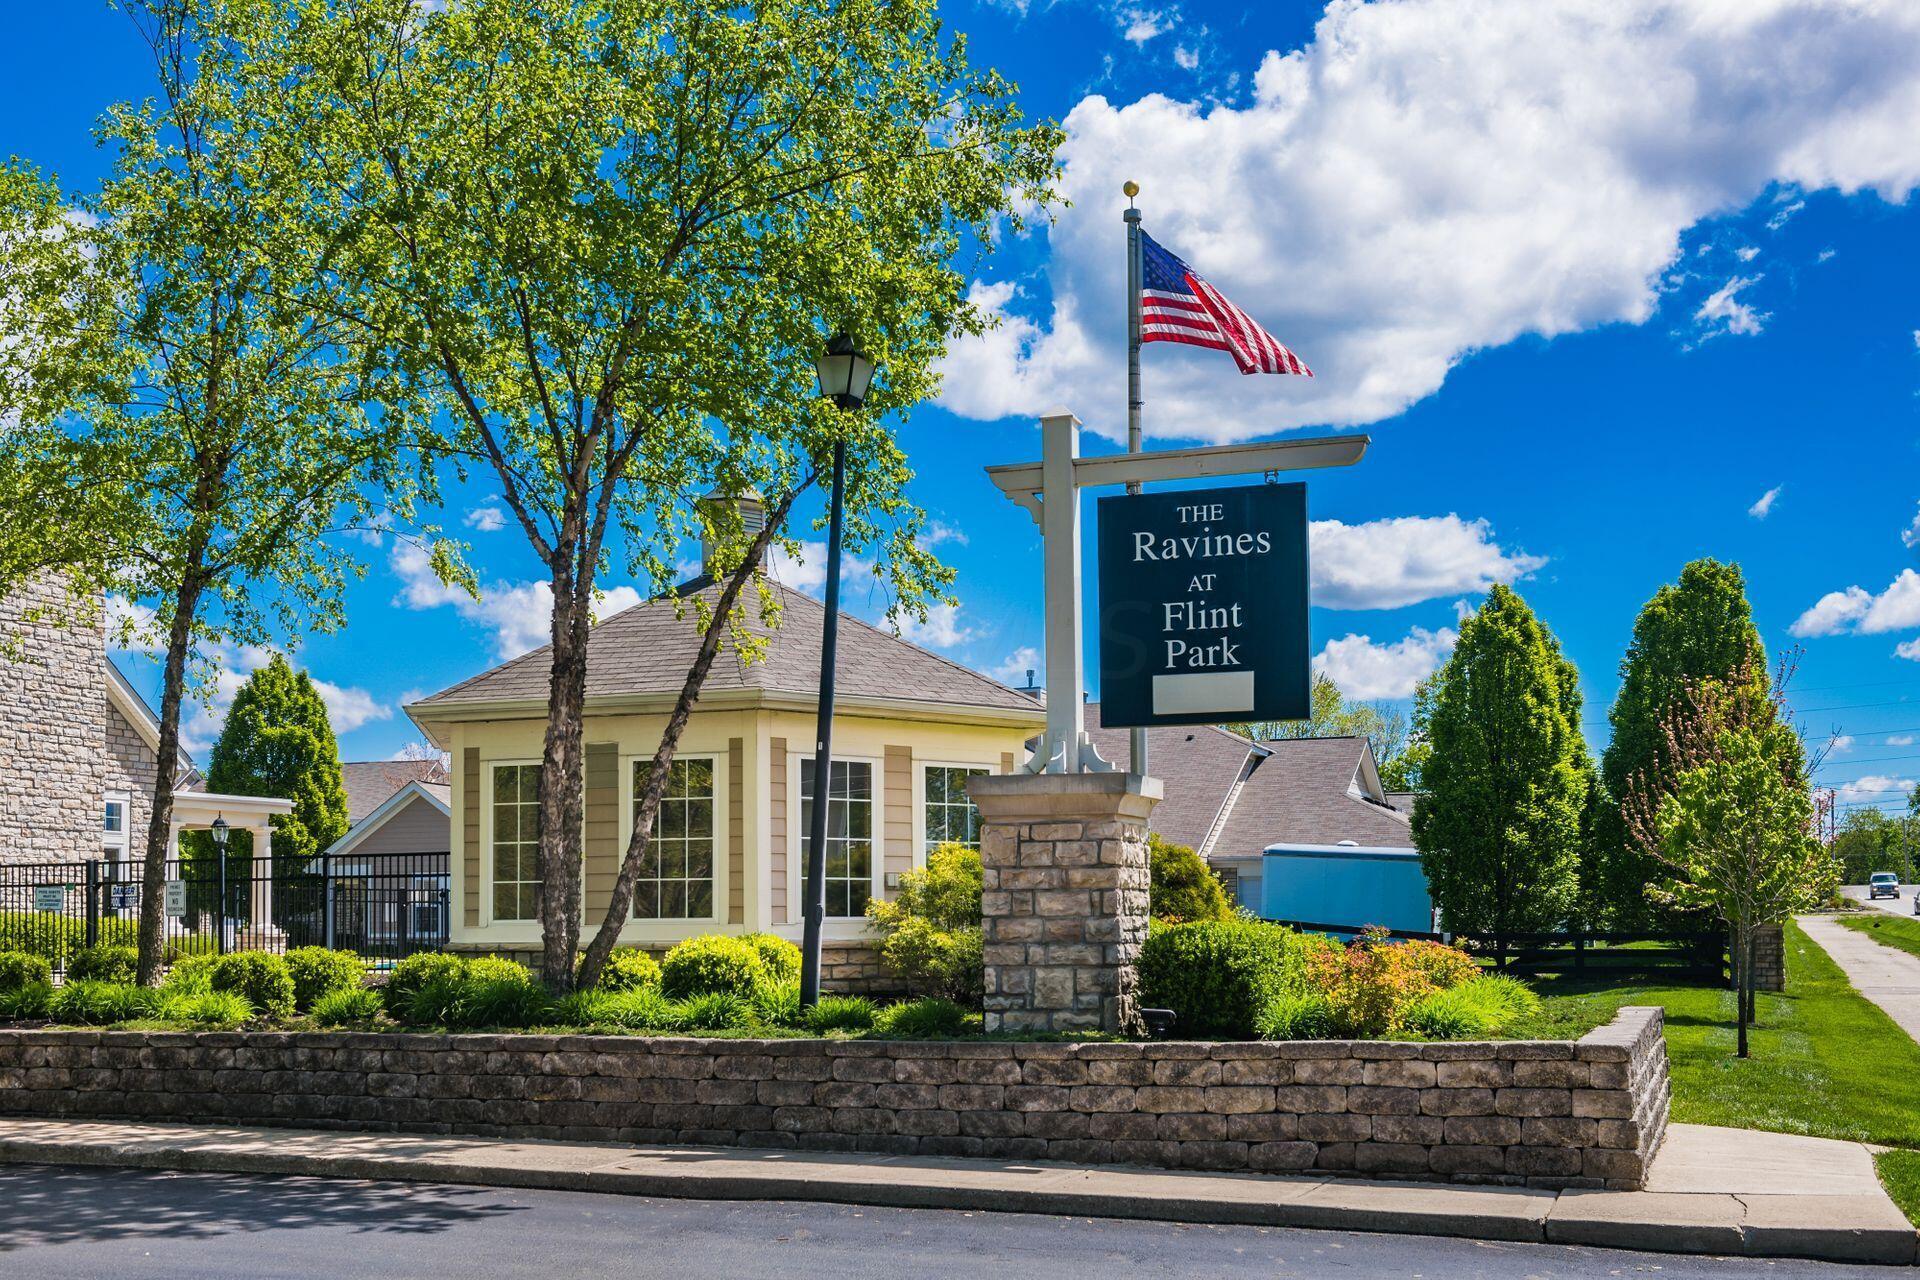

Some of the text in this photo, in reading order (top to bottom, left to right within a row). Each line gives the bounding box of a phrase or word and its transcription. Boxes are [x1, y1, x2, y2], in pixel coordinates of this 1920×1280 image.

[1177, 504, 1224, 523] THE
[1133, 527, 1270, 561] Ravines
[1188, 574, 1216, 592] AT
[1163, 600, 1242, 631] Flint
[1165, 636, 1241, 668] Park
